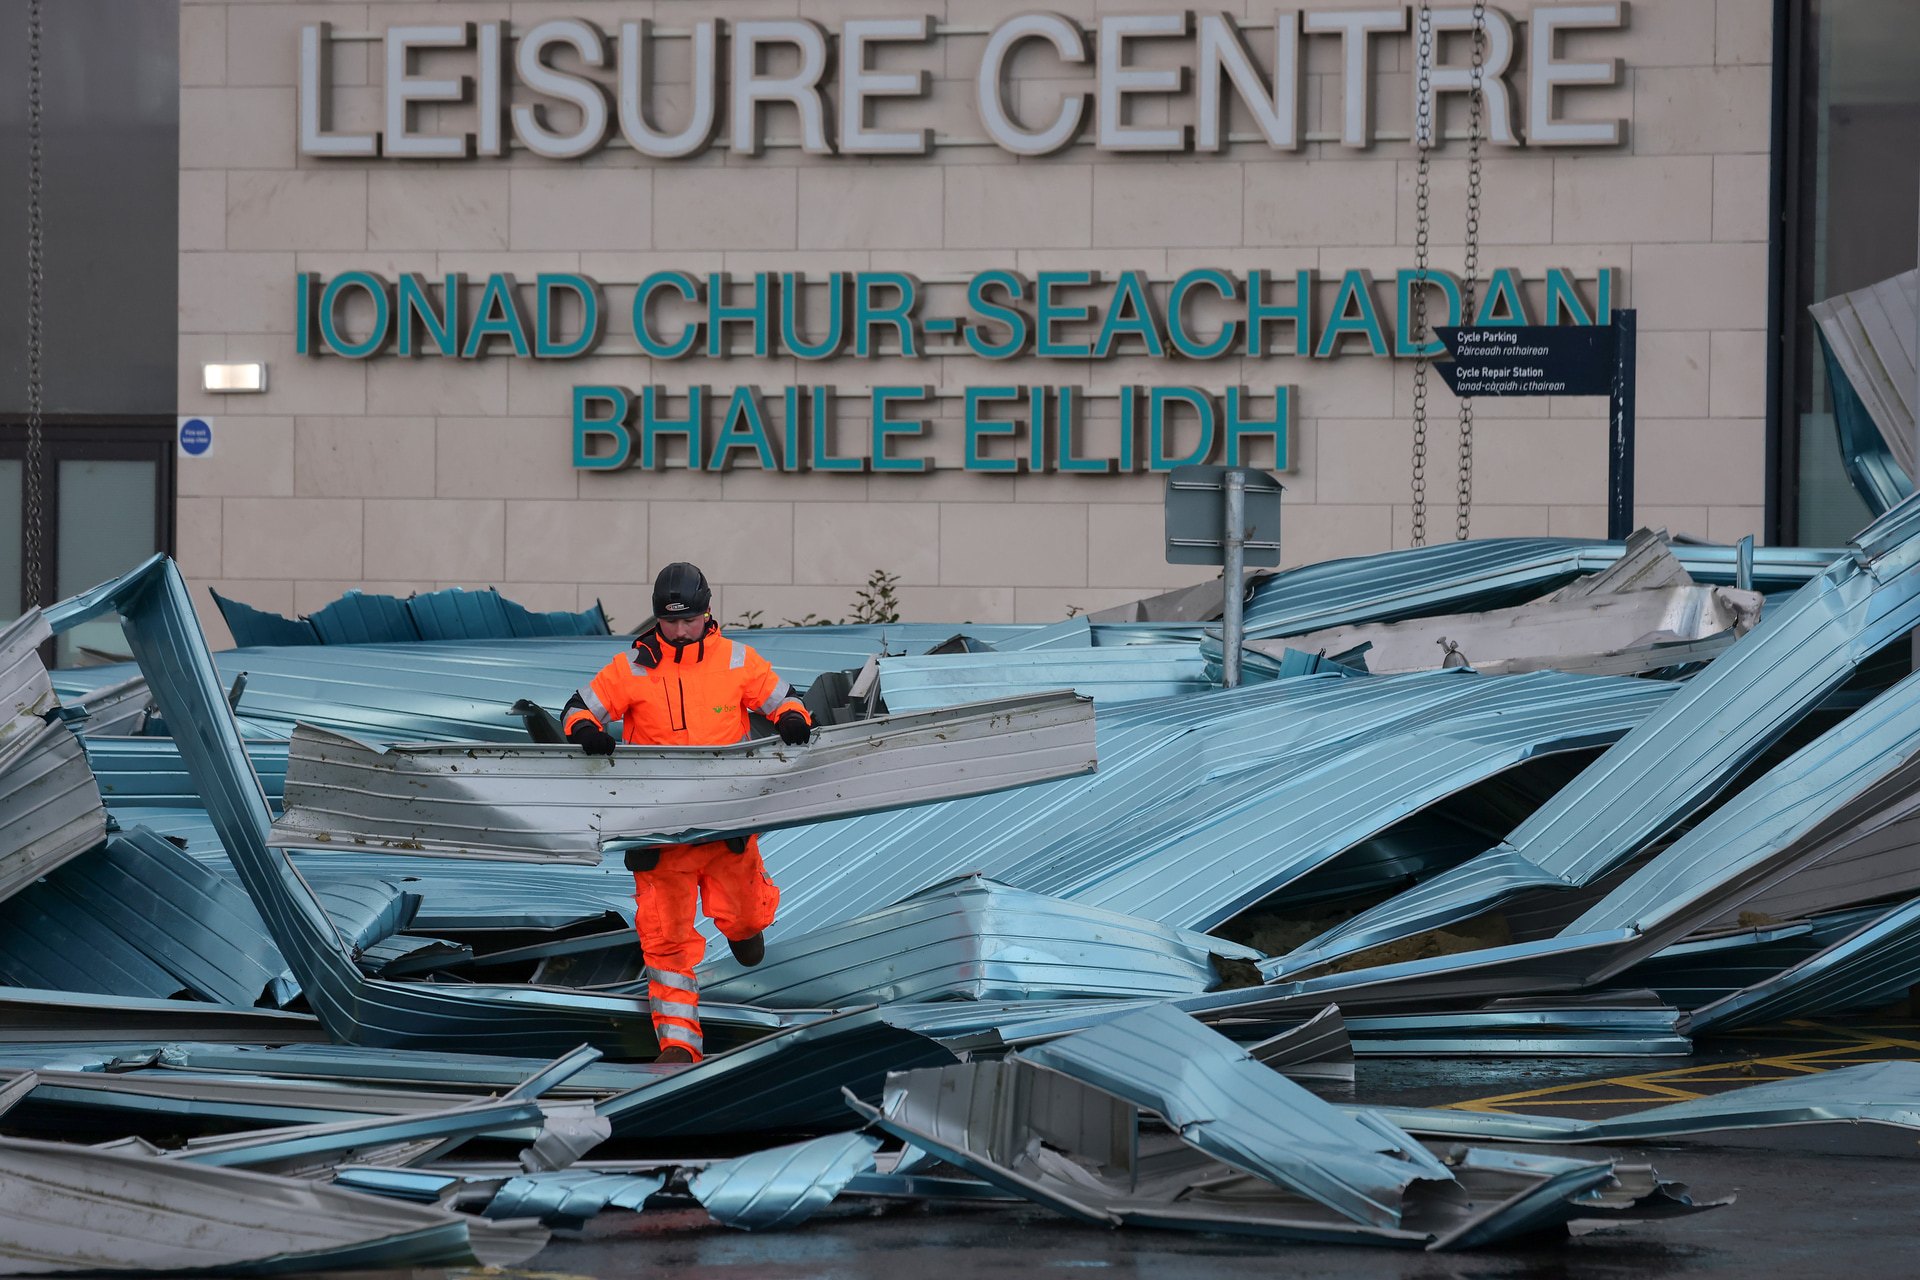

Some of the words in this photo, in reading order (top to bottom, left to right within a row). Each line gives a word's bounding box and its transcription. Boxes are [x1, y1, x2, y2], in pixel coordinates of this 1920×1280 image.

[301, 18, 930, 158] LEISURE
[975, 4, 1626, 155] CENTRE
[296, 270, 602, 359] IONAD
[631, 267, 1614, 359] CHUR-SEACHADAN
[1457, 331, 1481, 344] Cycle
[1482, 331, 1518, 344] Parking
[1456, 367, 1480, 379] Cycle
[1481, 367, 1511, 379] Repair
[1512, 367, 1544, 378] Station
[1503, 345, 1549, 356] rothairean
[571, 384, 928, 471] BHAILE
[963, 385, 1292, 472] EILIDH
